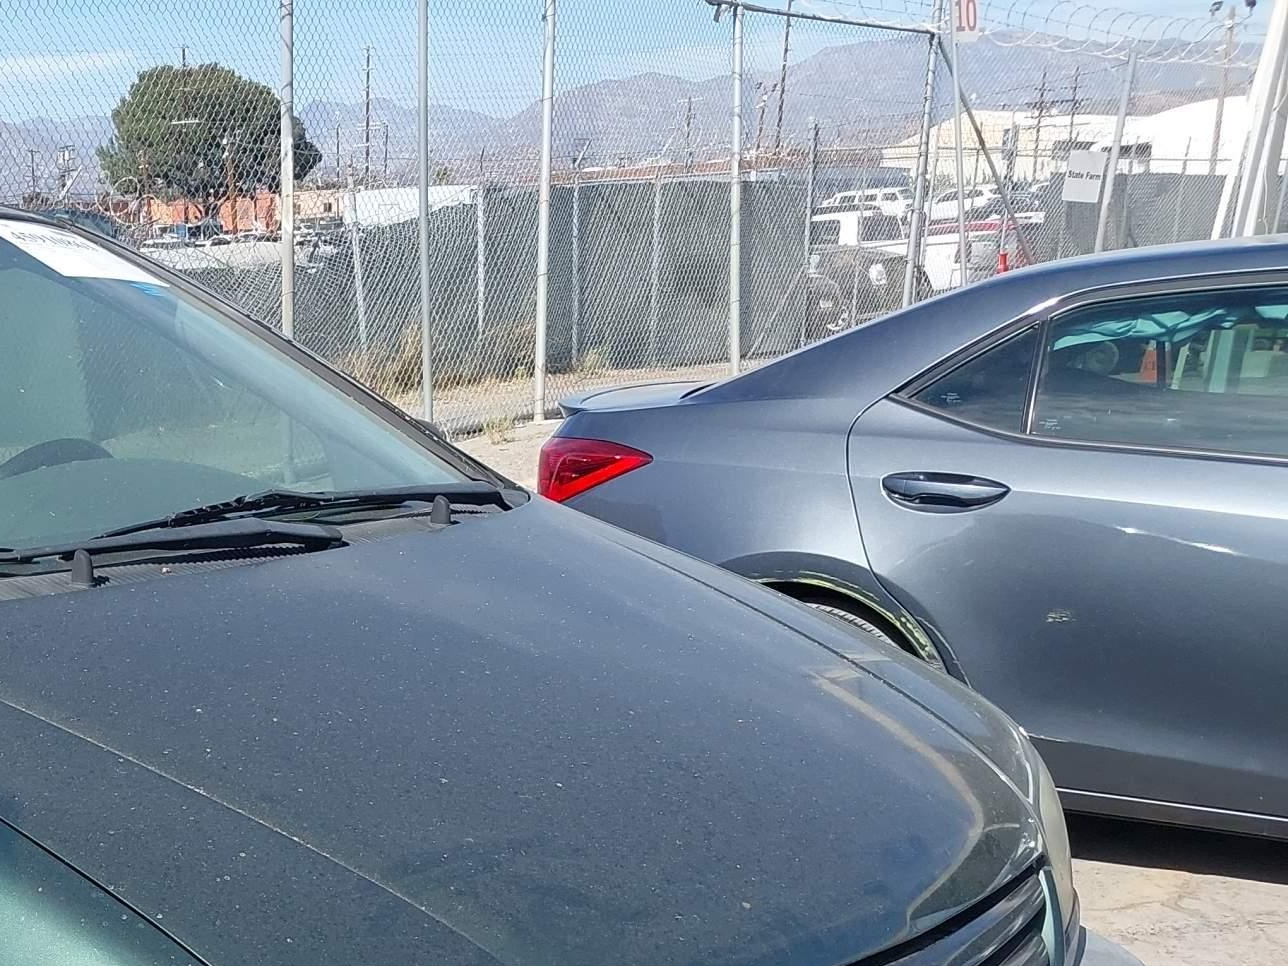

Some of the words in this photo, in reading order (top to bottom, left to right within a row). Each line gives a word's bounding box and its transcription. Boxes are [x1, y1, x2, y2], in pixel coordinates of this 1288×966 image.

[955, 0, 977, 32] 10
[1067, 170, 1084, 179] State
[1085, 171, 1102, 181] Farm
